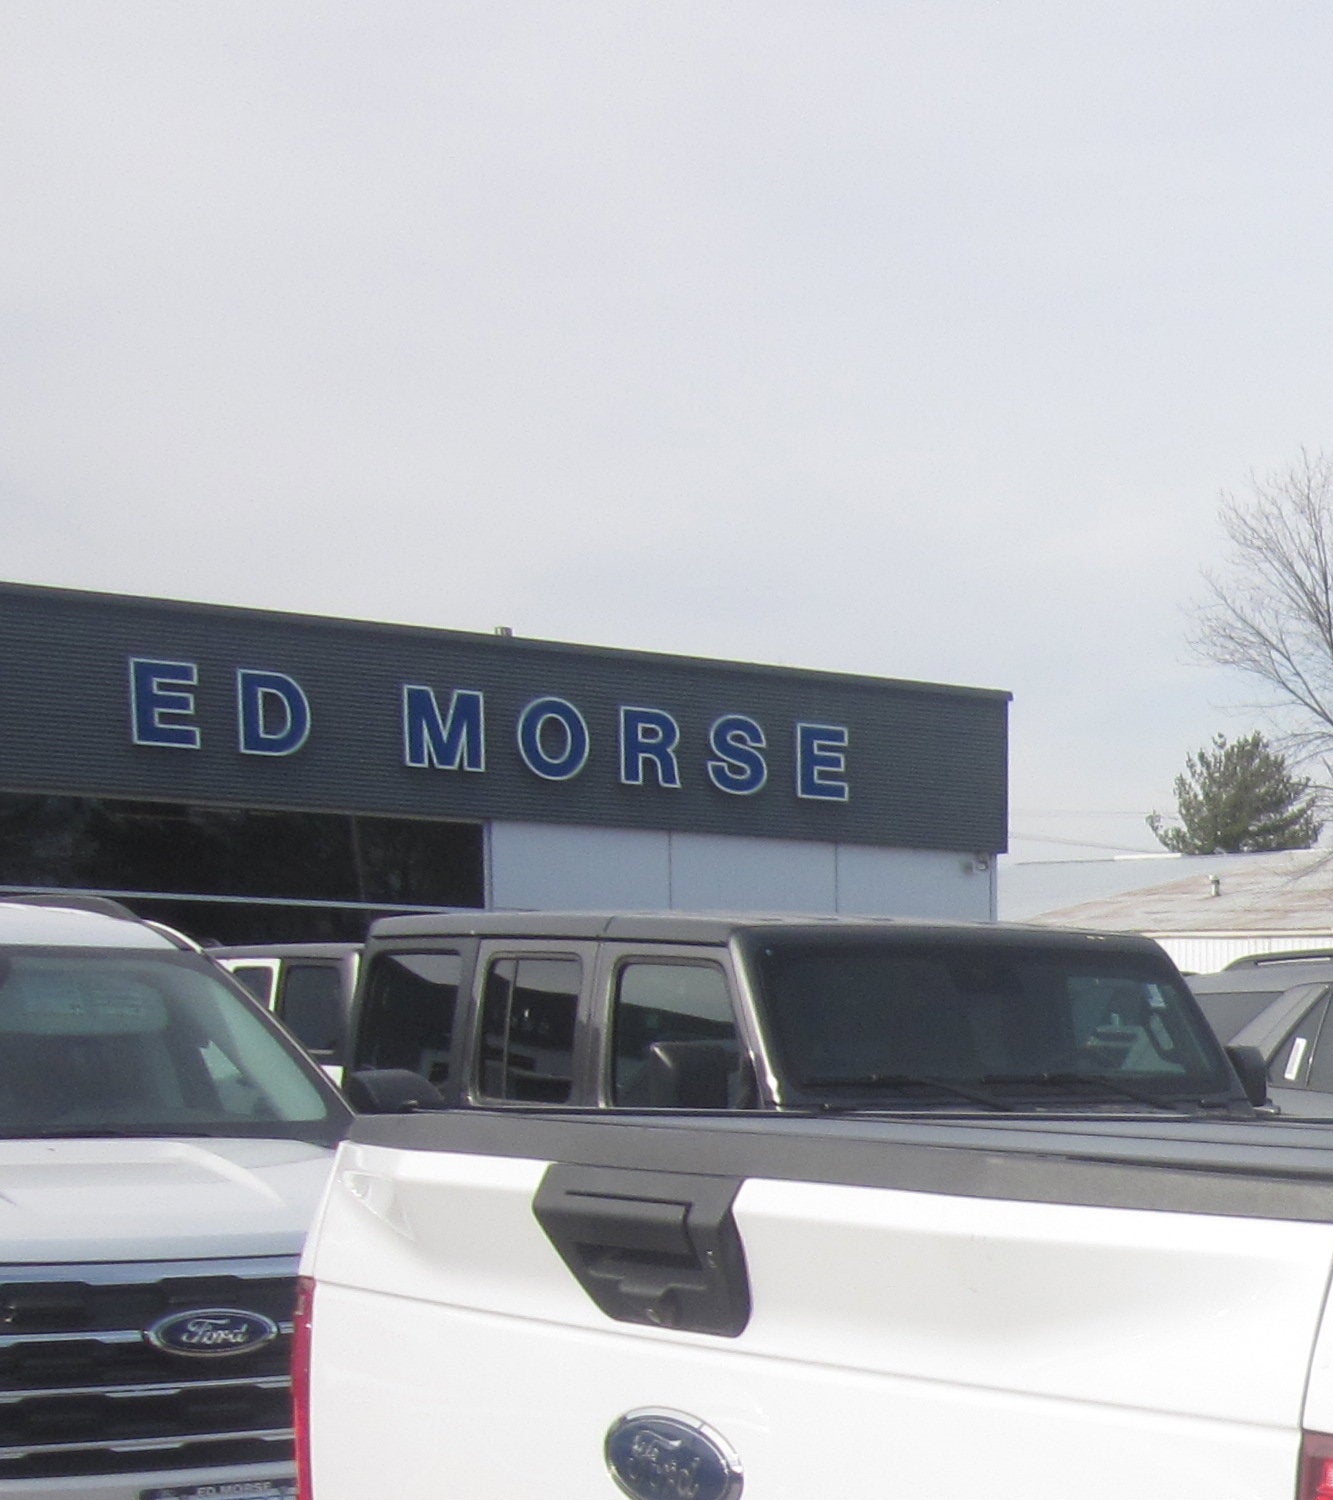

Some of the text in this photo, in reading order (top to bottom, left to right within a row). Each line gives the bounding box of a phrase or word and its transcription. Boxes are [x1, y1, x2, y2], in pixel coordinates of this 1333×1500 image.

[127, 656, 850, 801] ED MORSE
[181, 1317, 249, 1344] Ford
[629, 1429, 700, 1498] Ford
